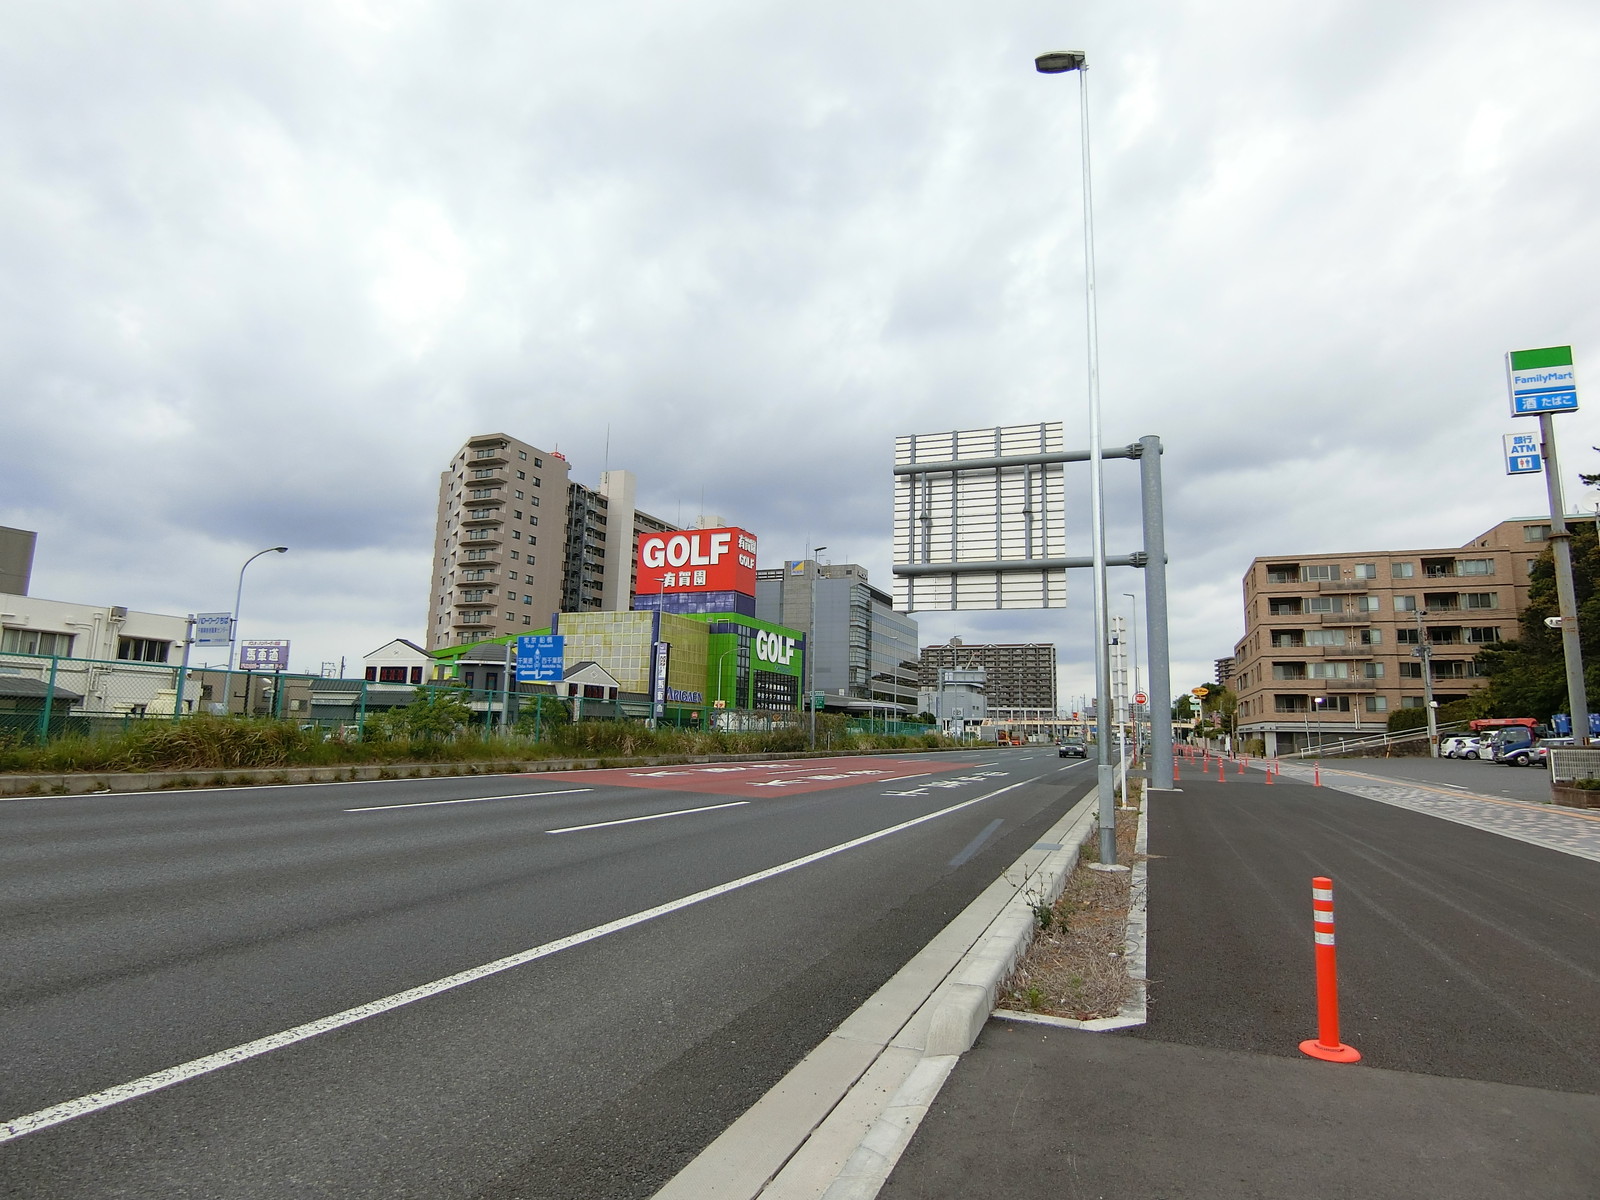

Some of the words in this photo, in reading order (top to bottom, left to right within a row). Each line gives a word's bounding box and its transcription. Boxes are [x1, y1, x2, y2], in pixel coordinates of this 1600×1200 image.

[1514, 371, 1573, 384] FamilyMart
[1522, 397, 1537, 410] 酒
[1541, 395, 1573, 407] たばこ
[1513, 435, 1533, 445] 銀行
[1511, 444, 1536, 454] ATM
[643, 532, 732, 568] GOLF
[739, 553, 755, 569] GOLF
[663, 569, 706, 587] 有賀園
[246, 648, 280, 661] 馬車道
[756, 629, 795, 666] GOLF
[667, 686, 703, 704] ARIGAEN
